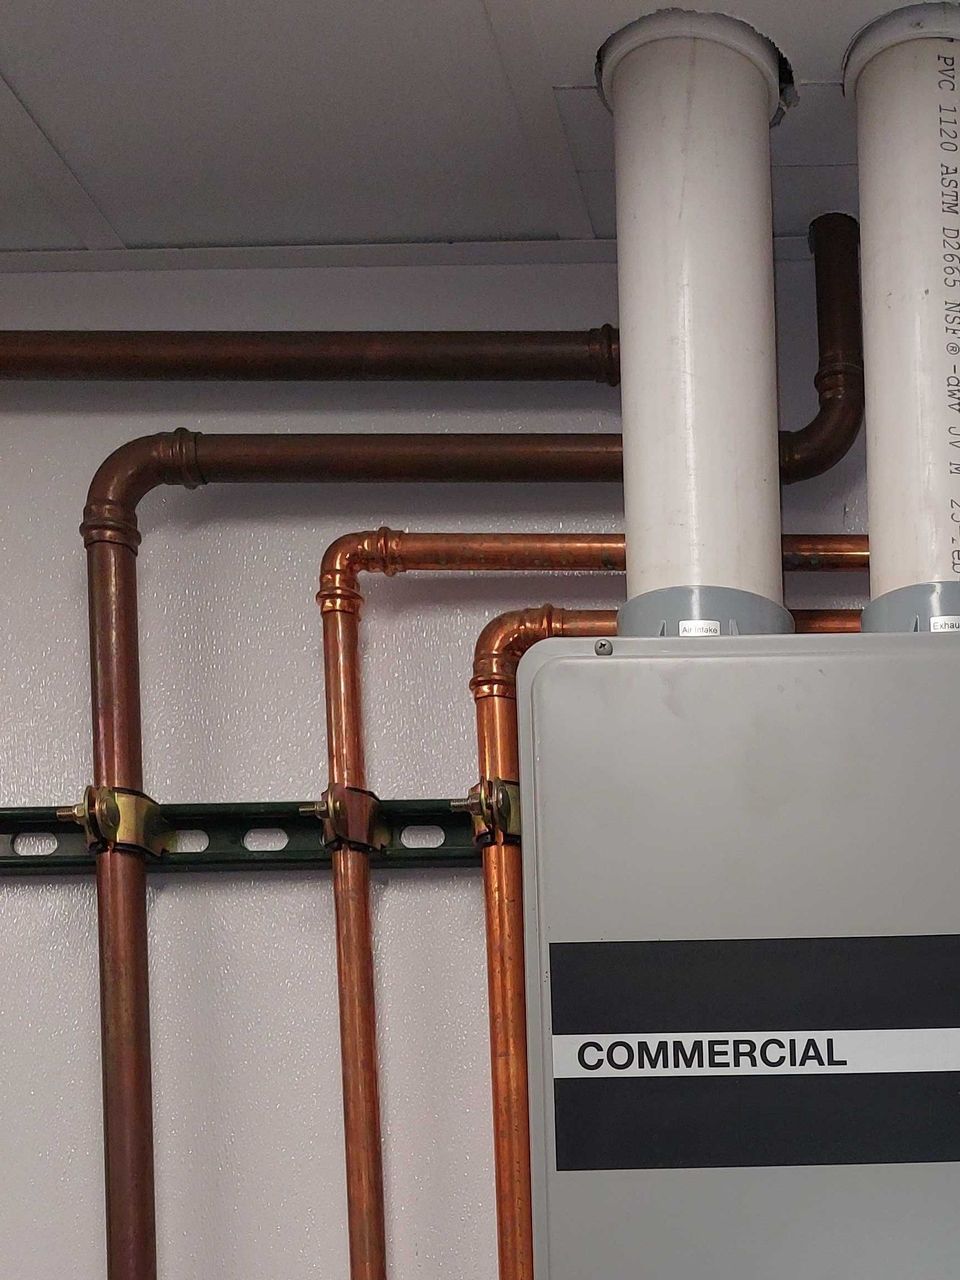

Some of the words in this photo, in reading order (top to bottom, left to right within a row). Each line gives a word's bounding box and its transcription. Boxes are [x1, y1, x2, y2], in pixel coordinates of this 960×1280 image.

[937, 54, 955, 91] PVC
[938, 104, 958, 152] 1120
[940, 164, 960, 215] ASTM
[578, 1038, 847, 1070] COMMERCIAL
